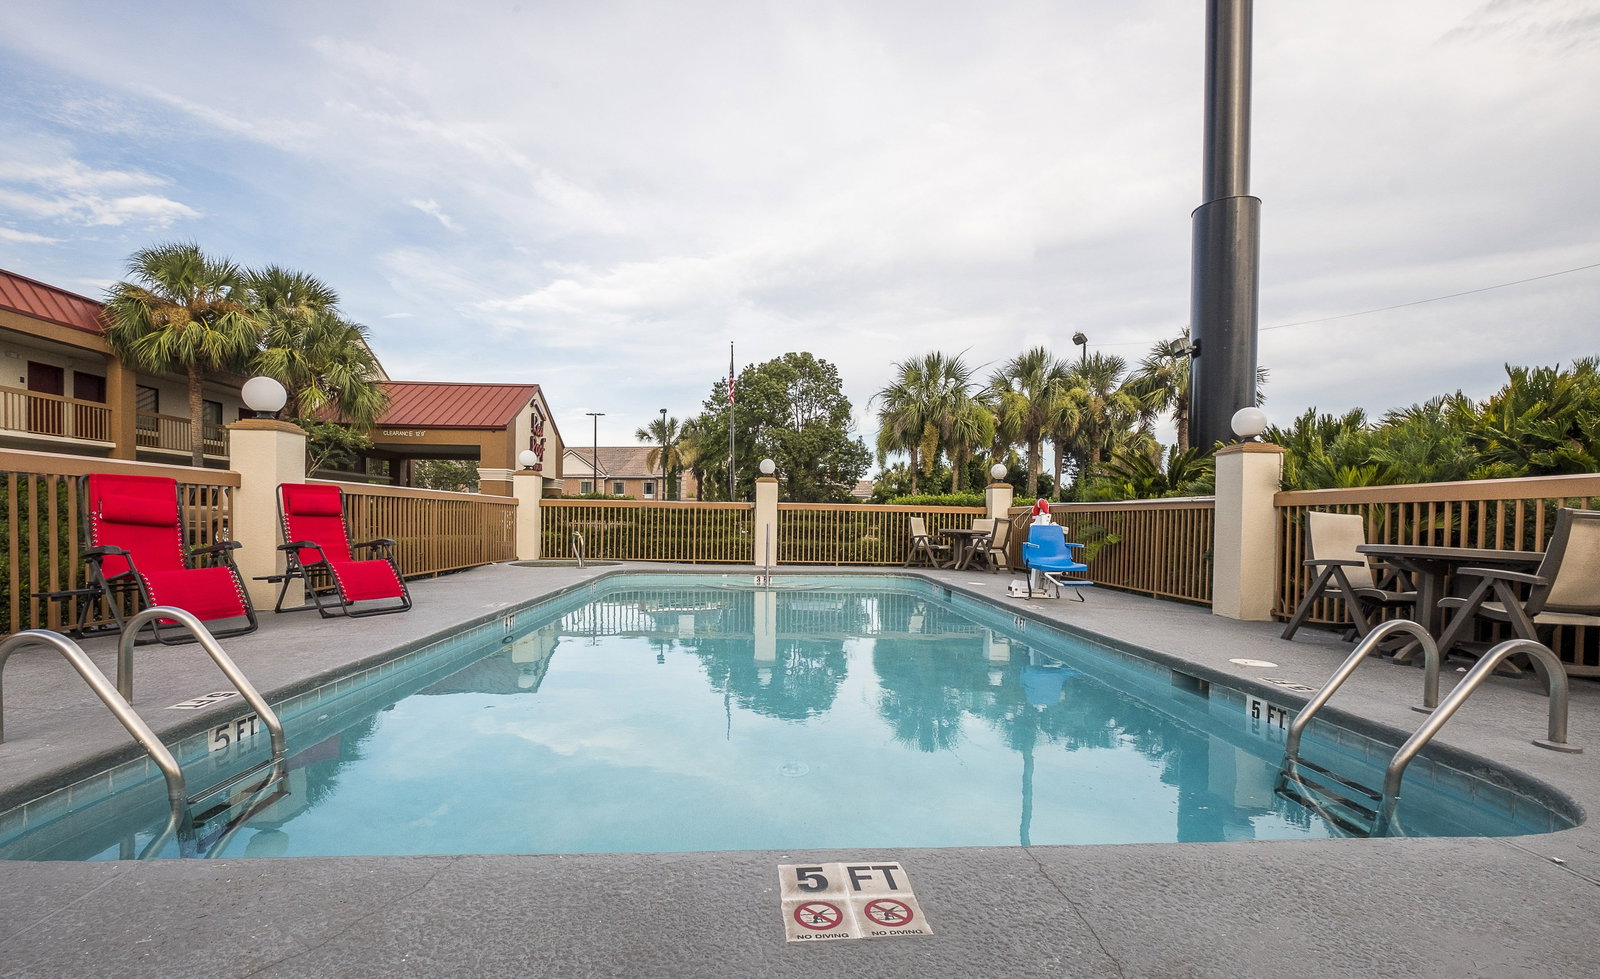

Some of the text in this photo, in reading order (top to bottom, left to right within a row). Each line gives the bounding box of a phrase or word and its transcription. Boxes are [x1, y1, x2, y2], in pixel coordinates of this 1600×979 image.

[1251, 699, 1262, 720] 5
[213, 723, 231, 752] 5
[795, 865, 899, 893] 5 FT
[814, 932, 850, 940] DIVING
[889, 928, 924, 936] DIVING
